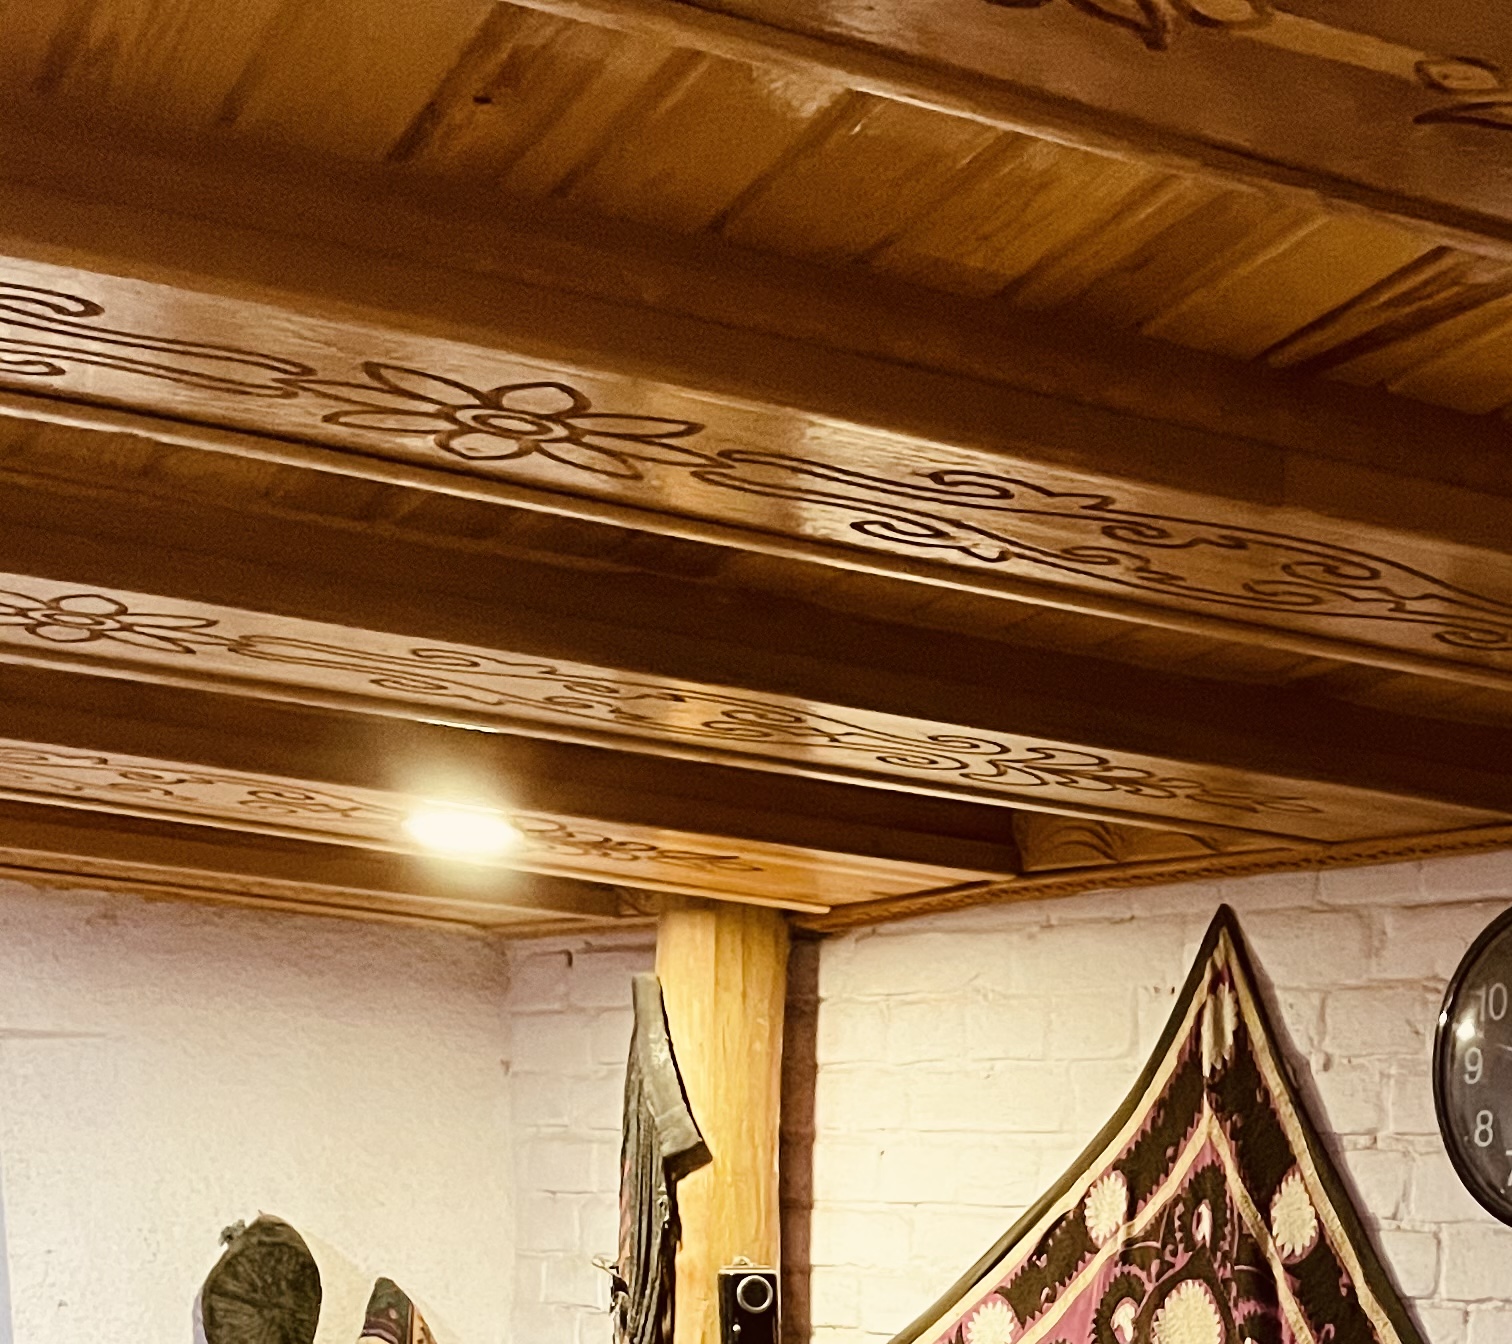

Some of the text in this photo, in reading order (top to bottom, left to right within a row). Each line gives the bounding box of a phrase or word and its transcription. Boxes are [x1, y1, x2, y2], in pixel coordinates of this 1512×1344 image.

[1475, 982, 1508, 1021] 10
[1464, 1047, 1483, 1084] 9
[1474, 1110, 1493, 1147] 8
